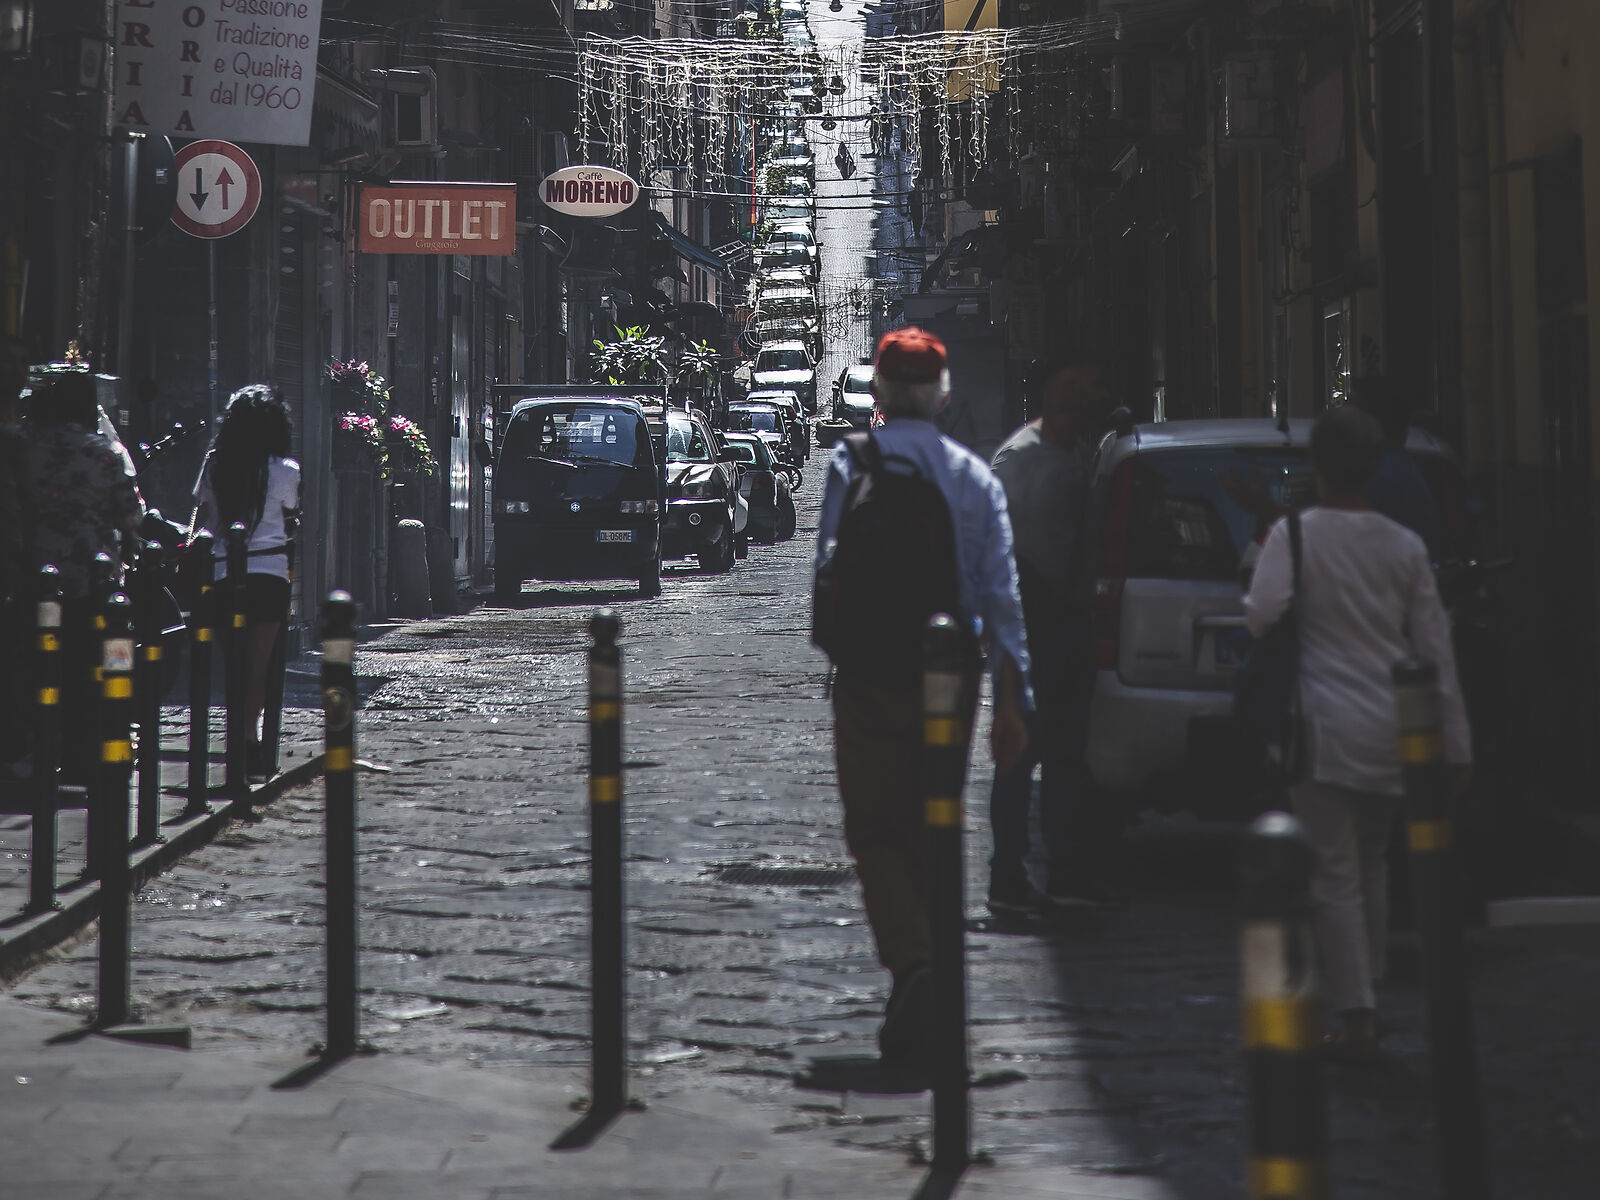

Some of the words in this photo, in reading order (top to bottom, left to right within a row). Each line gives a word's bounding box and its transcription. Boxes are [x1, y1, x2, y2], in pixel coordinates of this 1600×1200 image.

[214, 19, 311, 50] Tradizione
[214, 56, 226, 74] e
[231, 51, 304, 82] Qualità
[210, 80, 238, 107] dal
[244, 82, 302, 111] 1960
[545, 180, 634, 204] MORENO
[368, 197, 507, 241] OUTLET
